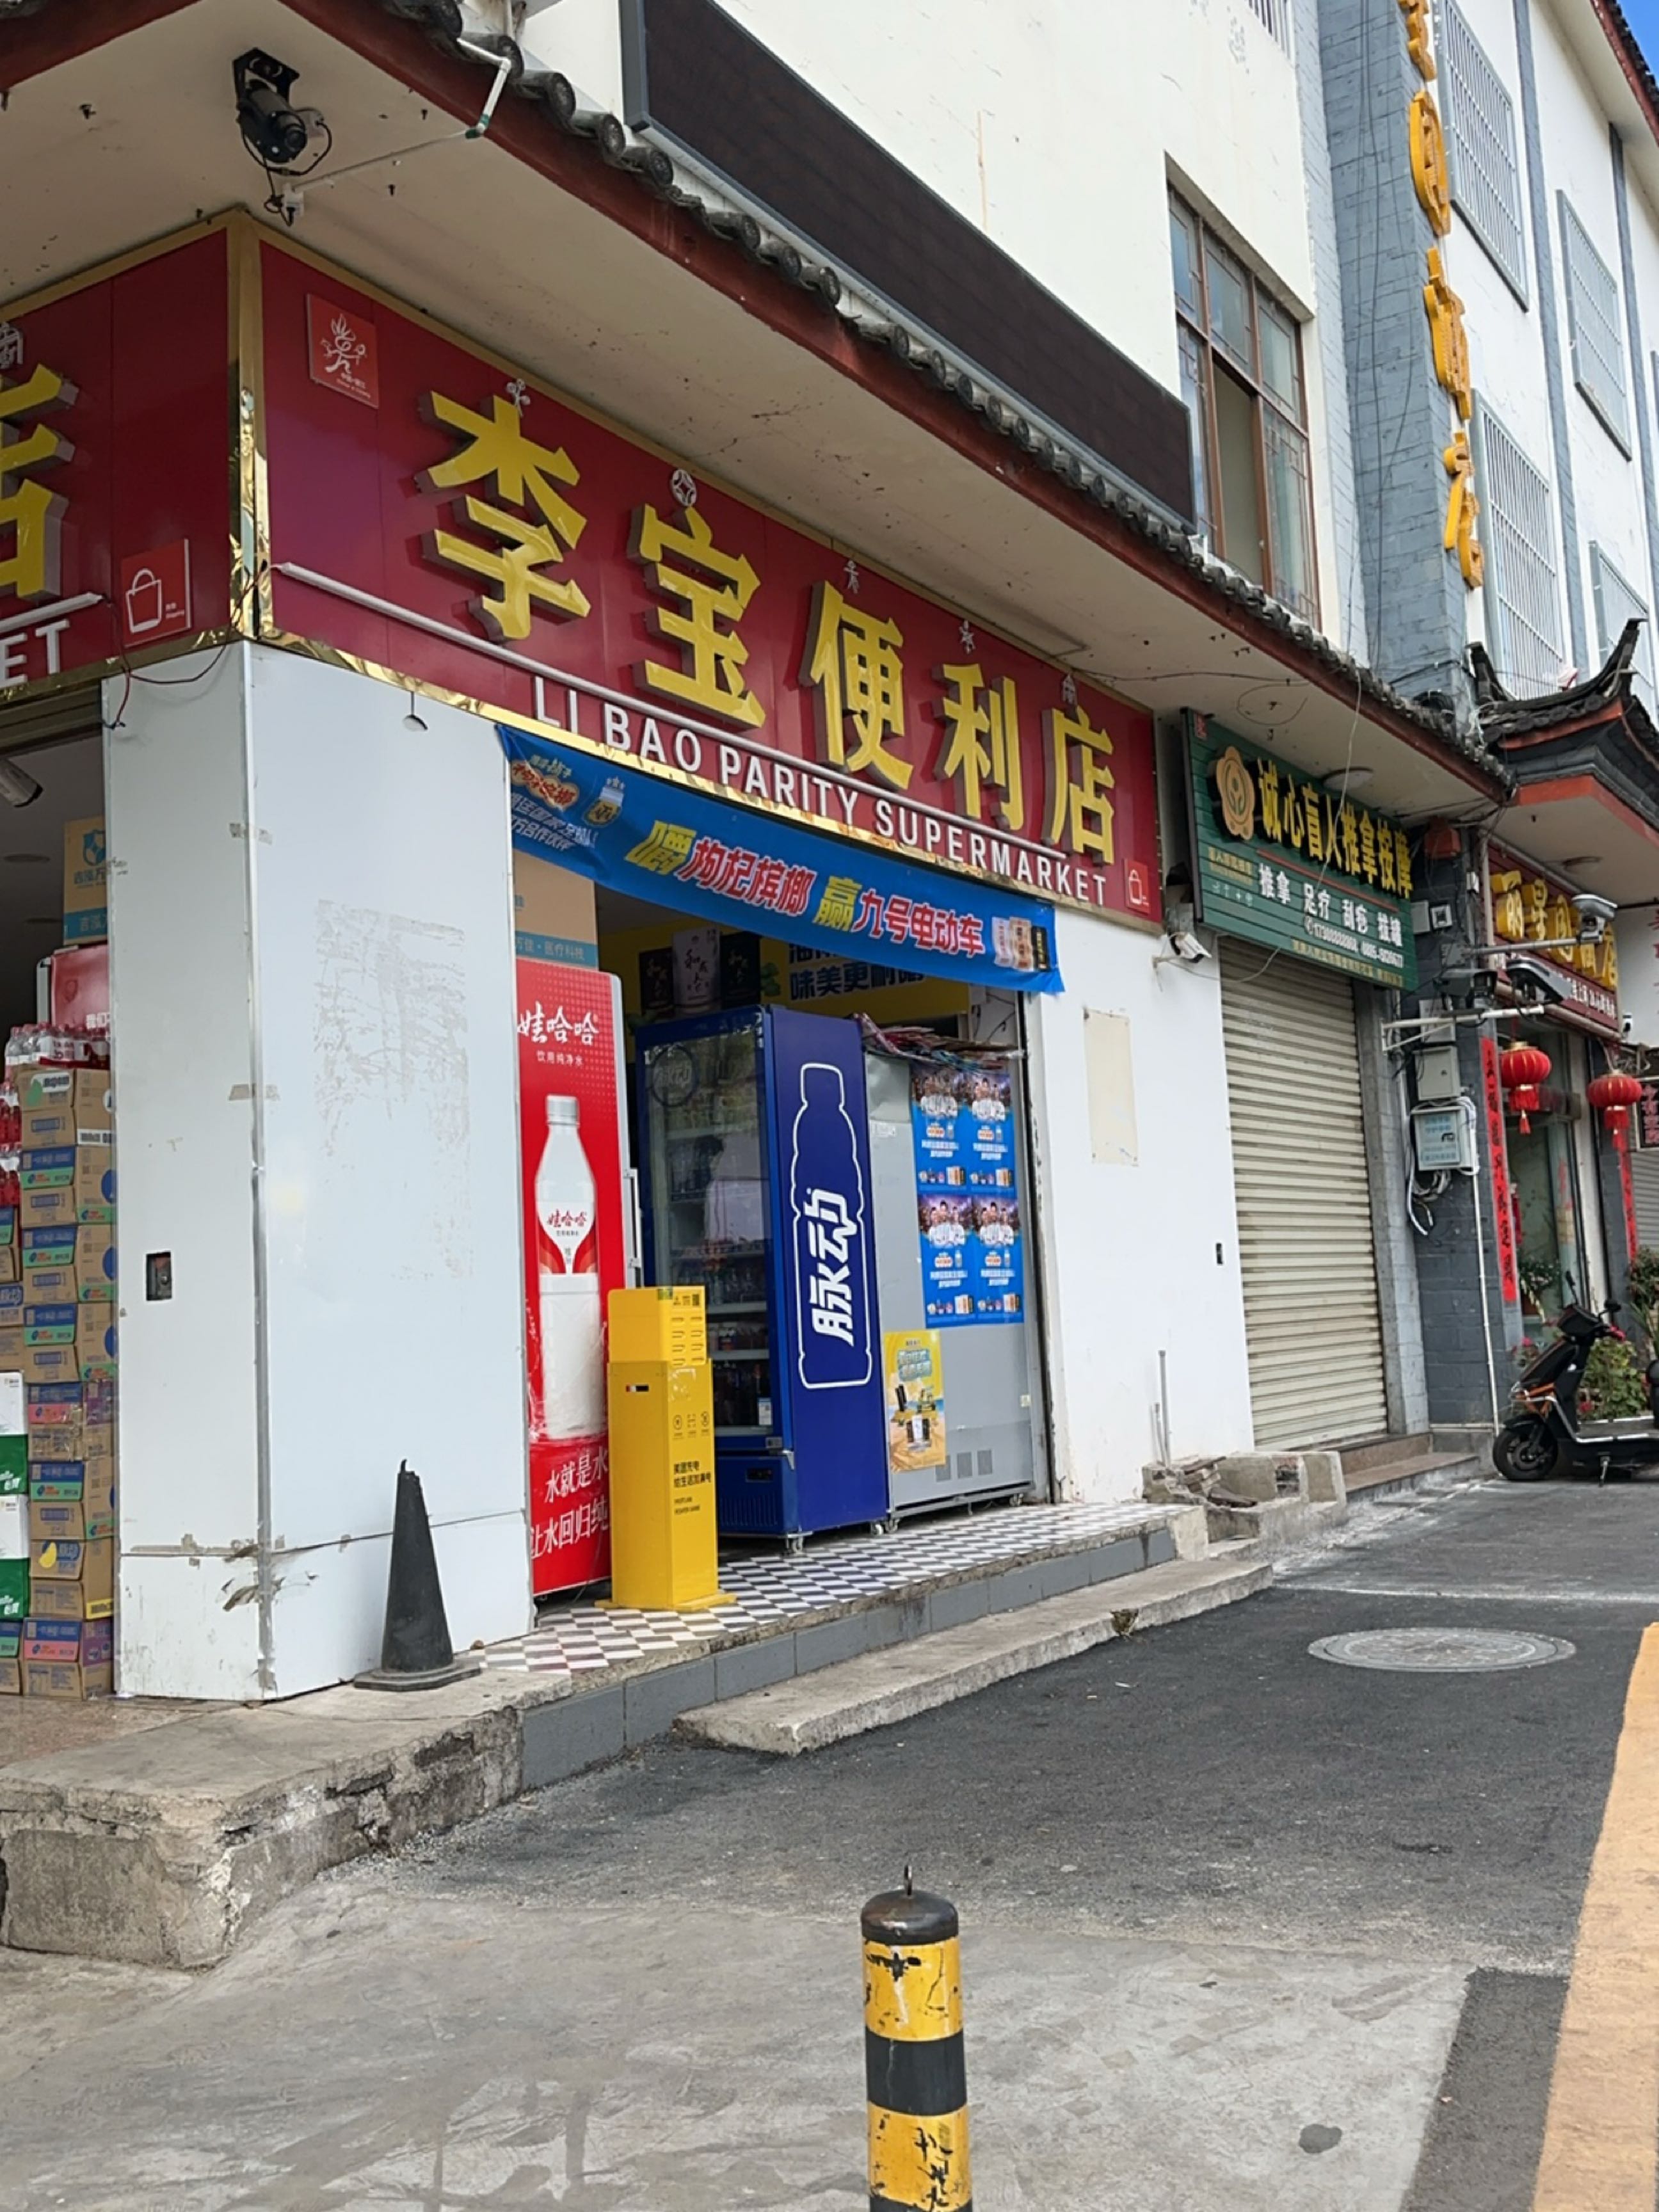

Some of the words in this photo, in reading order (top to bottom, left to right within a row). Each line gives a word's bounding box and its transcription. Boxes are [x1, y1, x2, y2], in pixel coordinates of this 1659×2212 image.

[417, 389, 1115, 866] 李宝便利店
[534, 676, 578, 734] LI
[604, 703, 703, 772] BAO
[719, 744, 859, 833] PARITY
[876, 799, 1107, 906] SUPERMARKET
[812, 875, 986, 958] 赢九号电动车
[1258, 862, 1291, 905] 推拿
[1302, 882, 1331, 920] 足疗
[517, 1000, 599, 1046] 娃哈哈
[804, 1187, 858, 1346] 脉动
[544, 1446, 609, 1503] 水就是水
